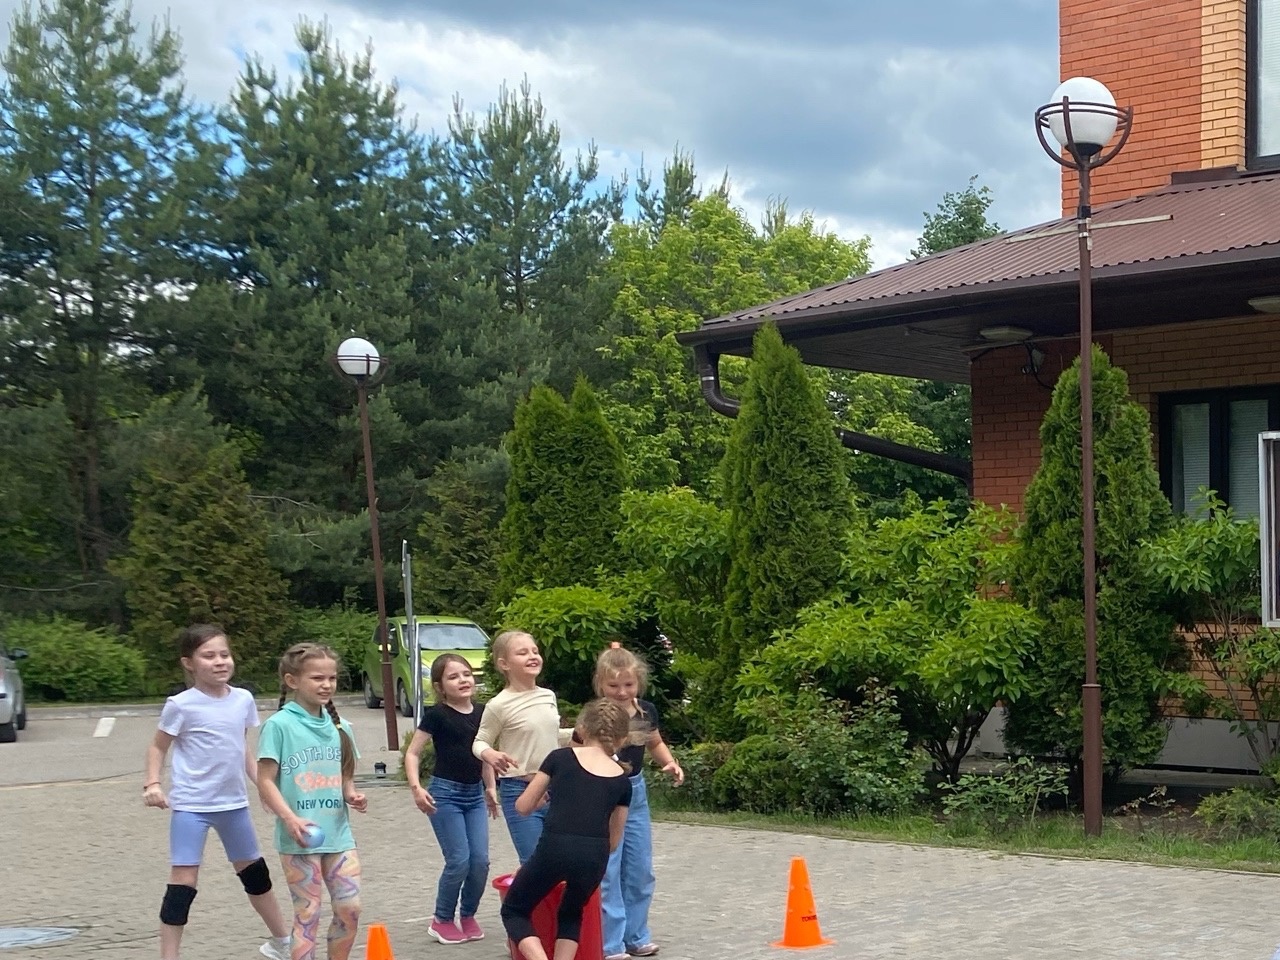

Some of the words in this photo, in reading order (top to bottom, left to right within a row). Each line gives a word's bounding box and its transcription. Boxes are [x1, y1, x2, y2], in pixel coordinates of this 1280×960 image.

[281, 746, 323, 775] SOUTH
[326, 746, 341, 761] BE
[297, 799, 316, 810] NEW
[318, 799, 341, 809] YOR
